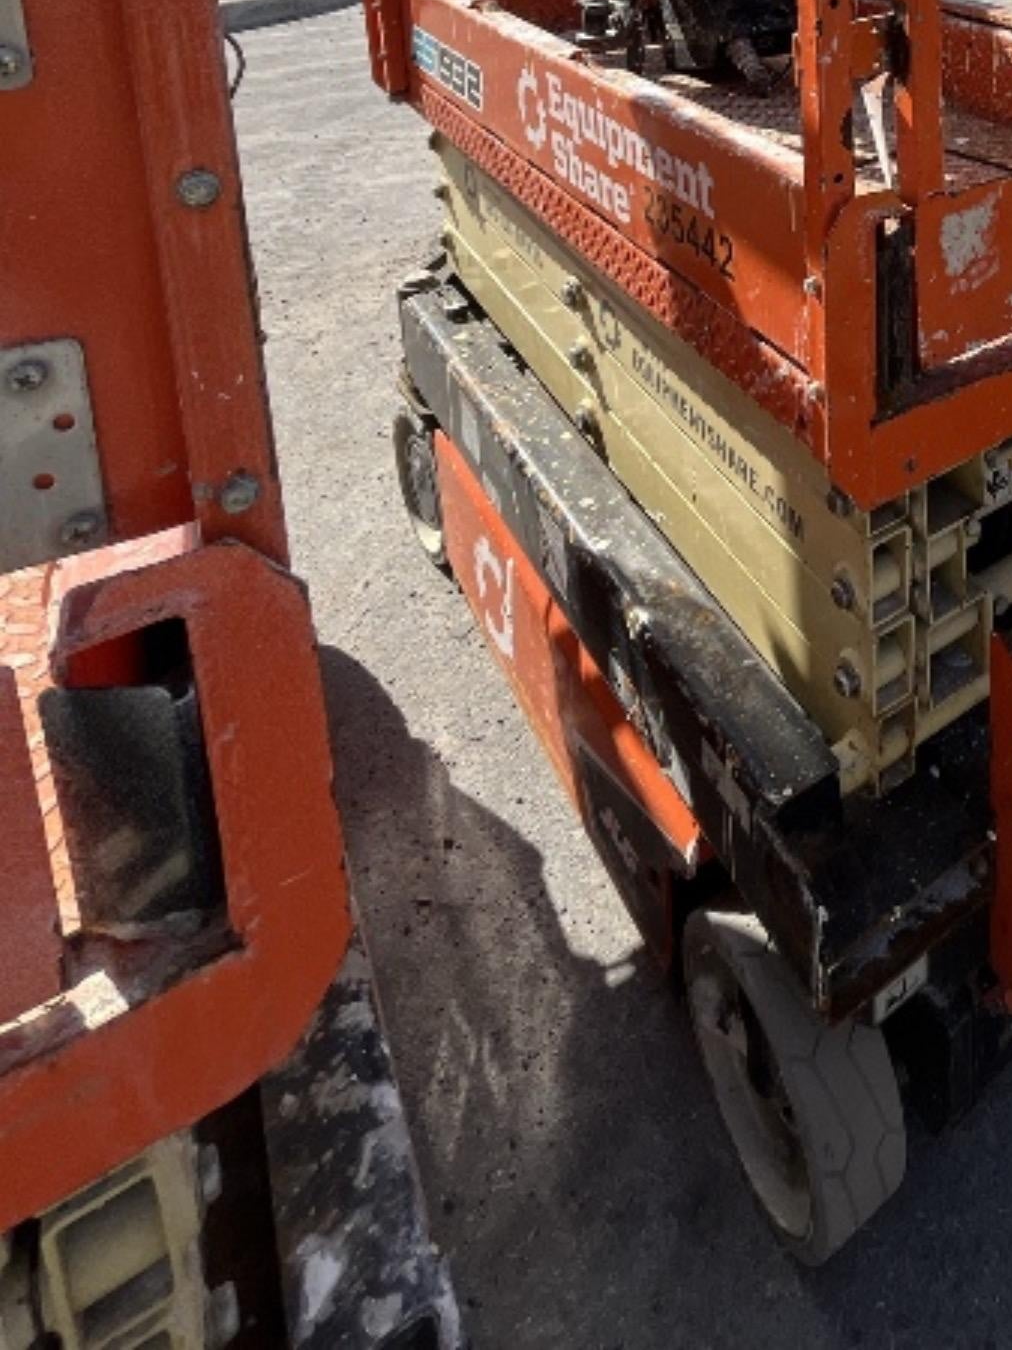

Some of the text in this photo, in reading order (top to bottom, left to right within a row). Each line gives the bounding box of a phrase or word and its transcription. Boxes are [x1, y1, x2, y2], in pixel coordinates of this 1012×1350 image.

[546, 71, 716, 220] Equipment
[551, 130, 632, 224] Share
[643, 185, 735, 282] 235442
